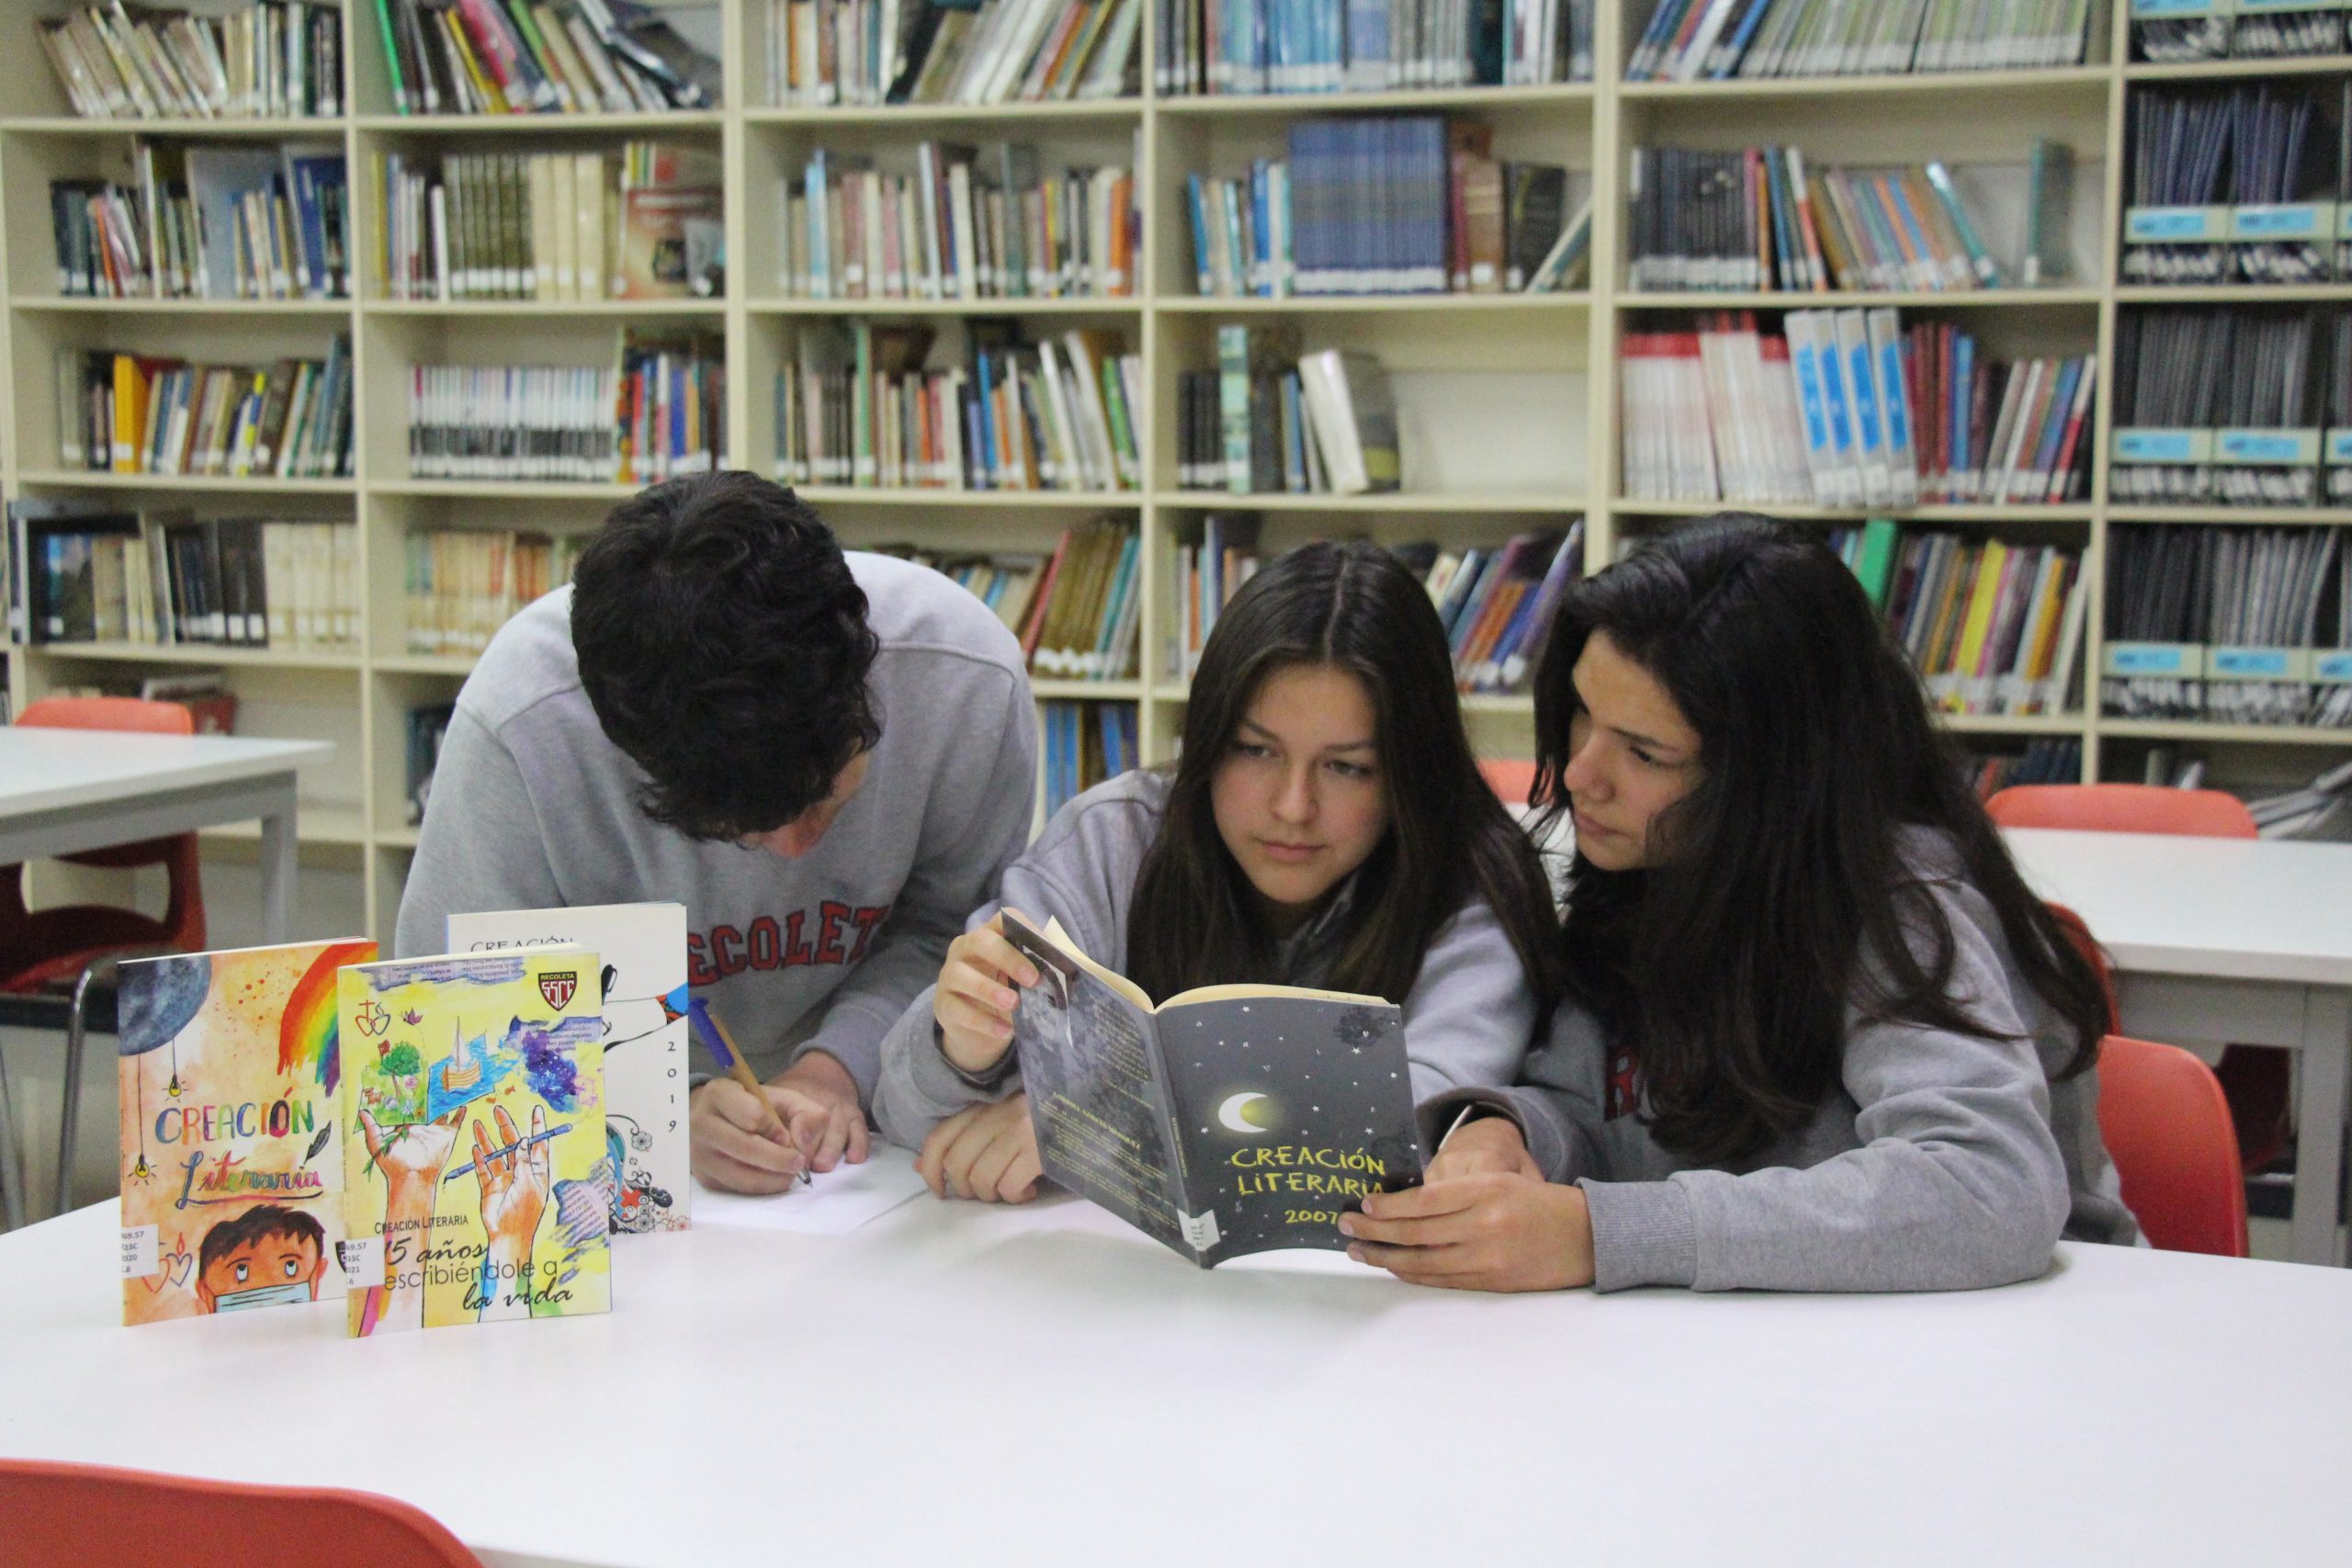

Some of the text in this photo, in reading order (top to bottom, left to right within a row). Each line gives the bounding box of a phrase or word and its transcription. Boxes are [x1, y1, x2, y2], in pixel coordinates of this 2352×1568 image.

[688, 899, 890, 987] ECOLET
[155, 1087, 314, 1145] CREACIÓN
[1230, 1145, 1385, 1176] CREACIÓN
[175, 1150, 323, 1210] Literaria
[1284, 1209, 1339, 1224] 2007
[121, 1230, 144, 1240] 69.57
[121, 1242, 138, 1250] 33C
[416, 1239, 491, 1264] años
[384, 1258, 558, 1291] escribiéndole a
[462, 1276, 573, 1311] la vida
